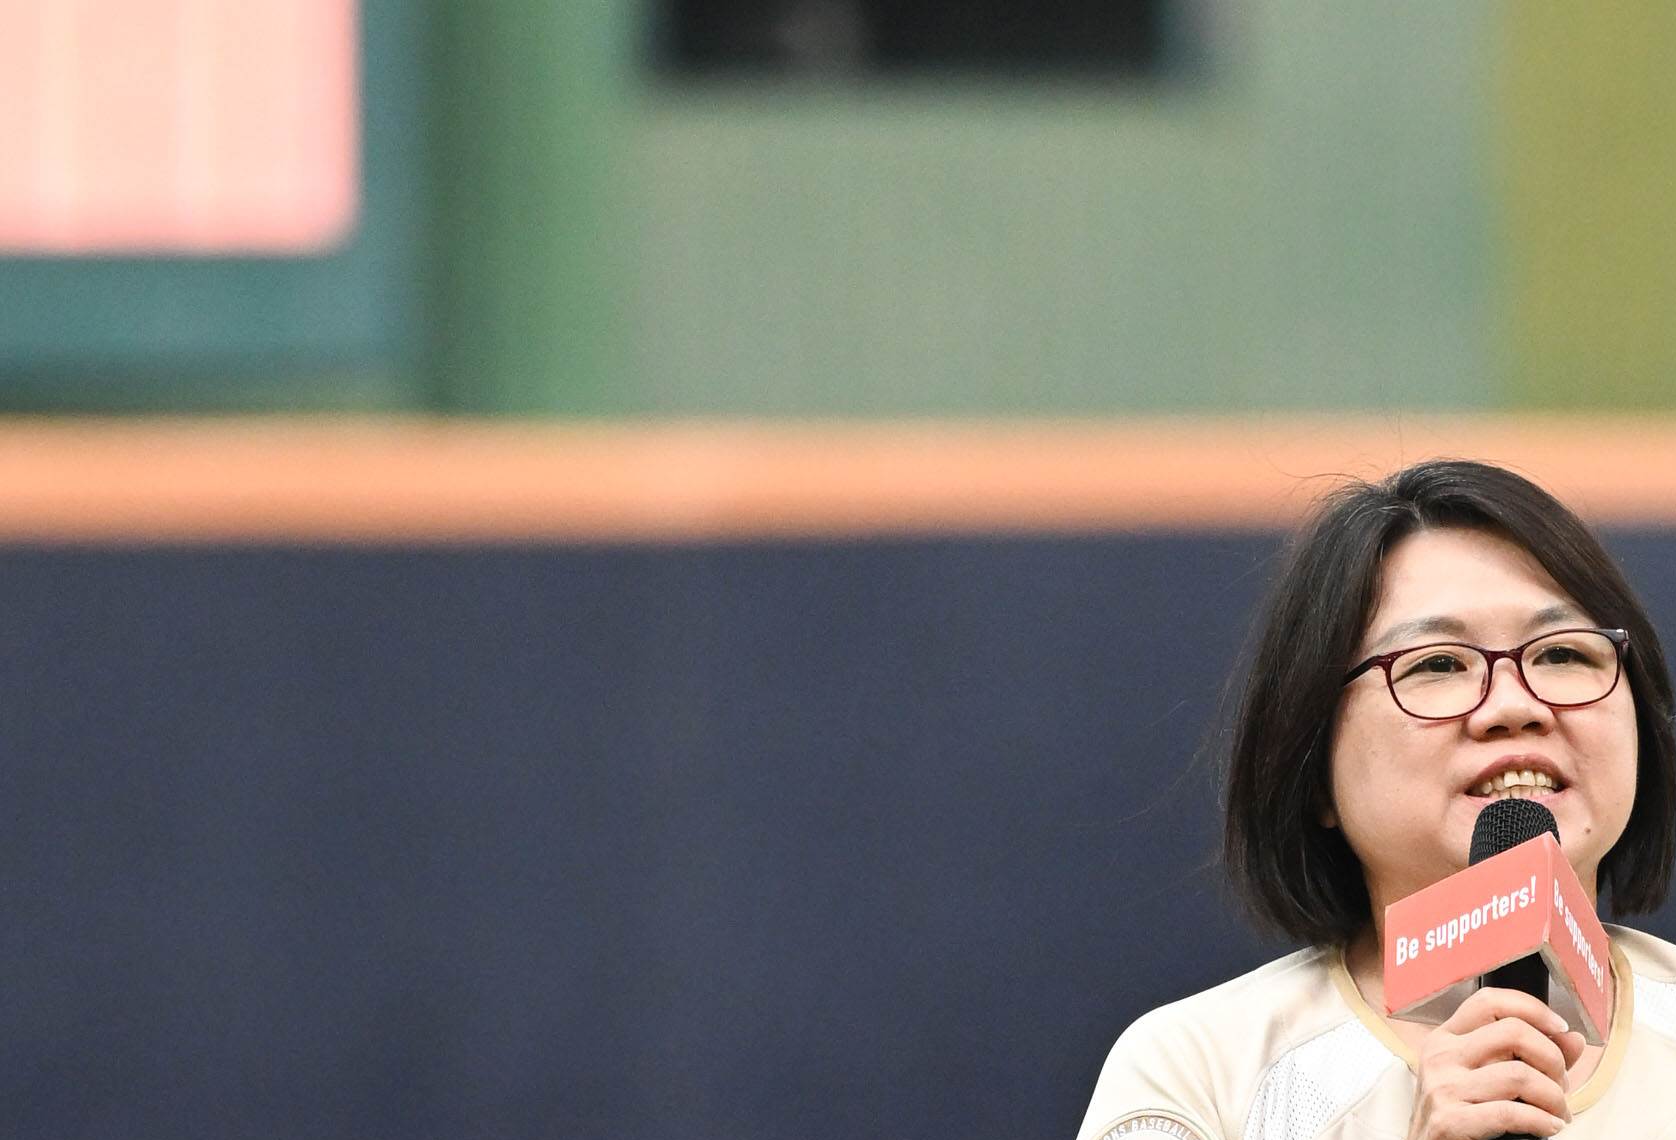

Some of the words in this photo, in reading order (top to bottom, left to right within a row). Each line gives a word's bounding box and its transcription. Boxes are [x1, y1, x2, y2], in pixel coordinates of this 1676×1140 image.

[1396, 937, 1419, 966] Be
[1425, 875, 1536, 952] supporters!
[1553, 879, 1564, 917] Be
[1564, 904, 1604, 992] supporters!
